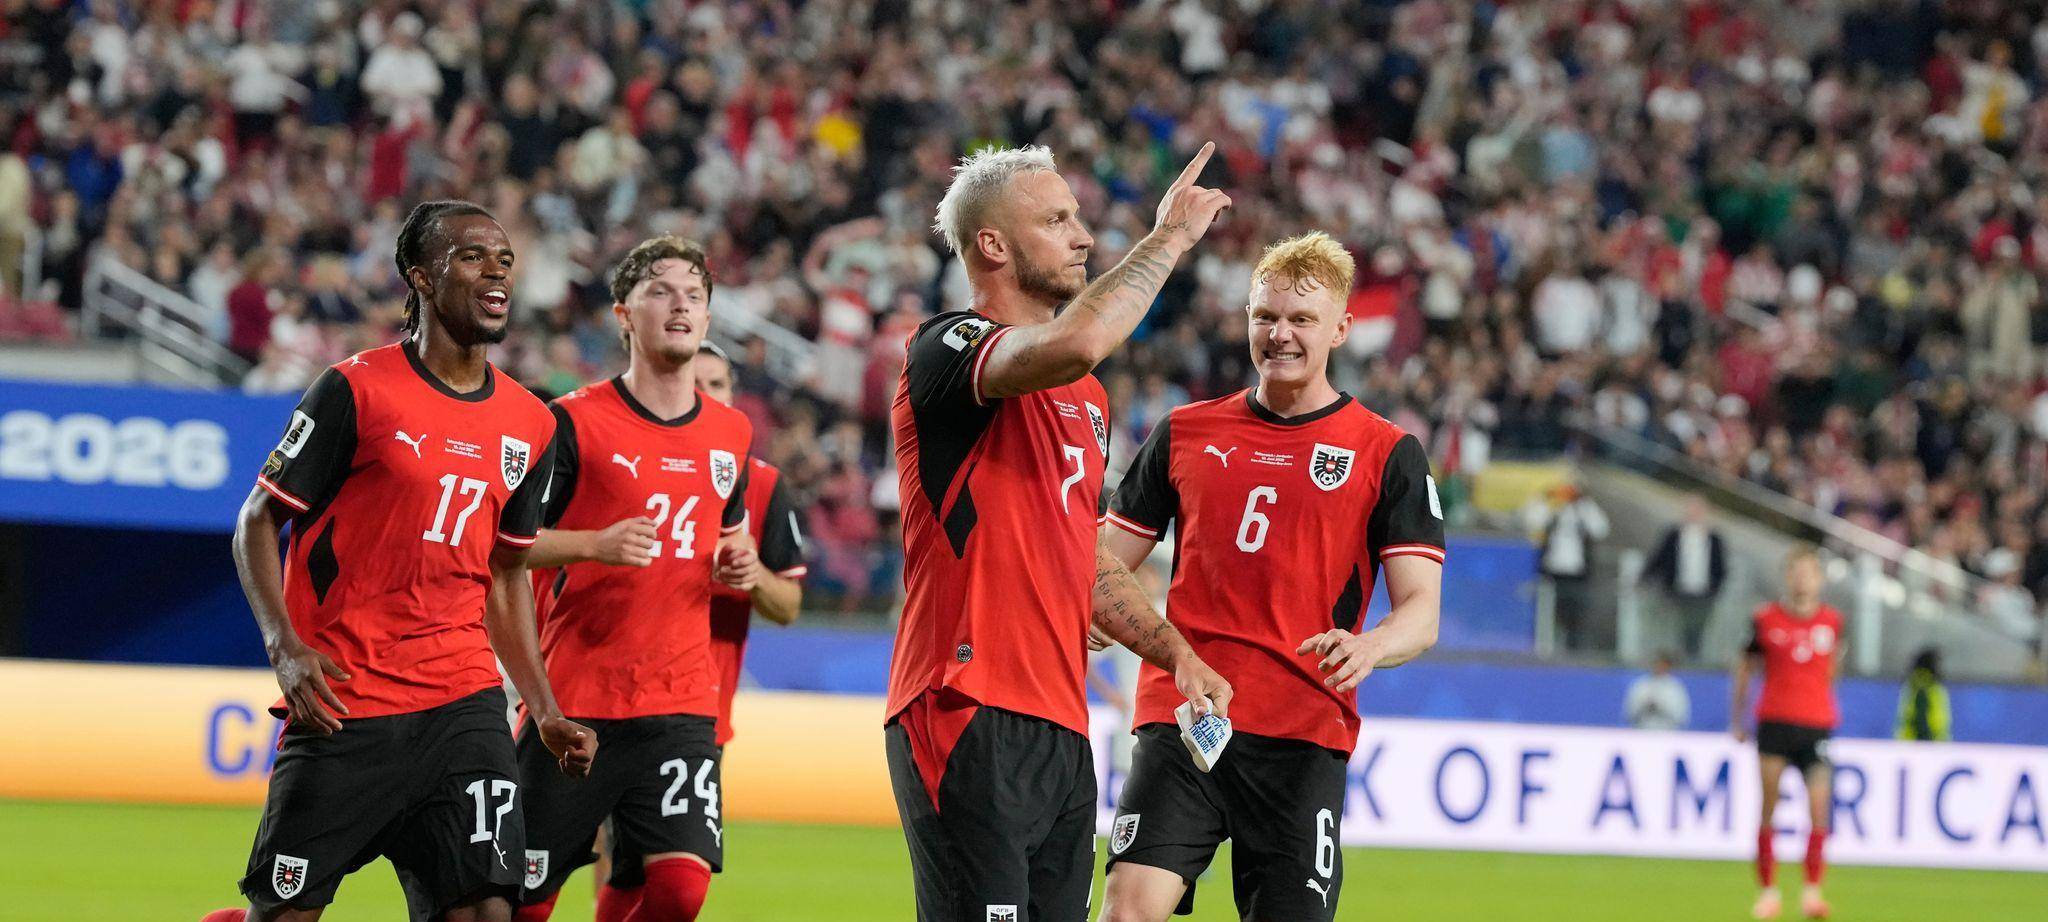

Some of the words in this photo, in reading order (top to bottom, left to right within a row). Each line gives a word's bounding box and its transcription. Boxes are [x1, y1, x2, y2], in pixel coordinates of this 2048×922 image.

[0, 409, 229, 491] 2026
[1061, 444, 1086, 516] 7
[422, 473, 490, 547] 17
[645, 493, 701, 559] 24
[1235, 485, 1278, 553] 6
[1195, 715, 1219, 749] UNITES
[465, 779, 518, 844] 17
[660, 758, 719, 819] 24
[1436, 747, 1552, 824] OF
[1315, 808, 1335, 879] 6
